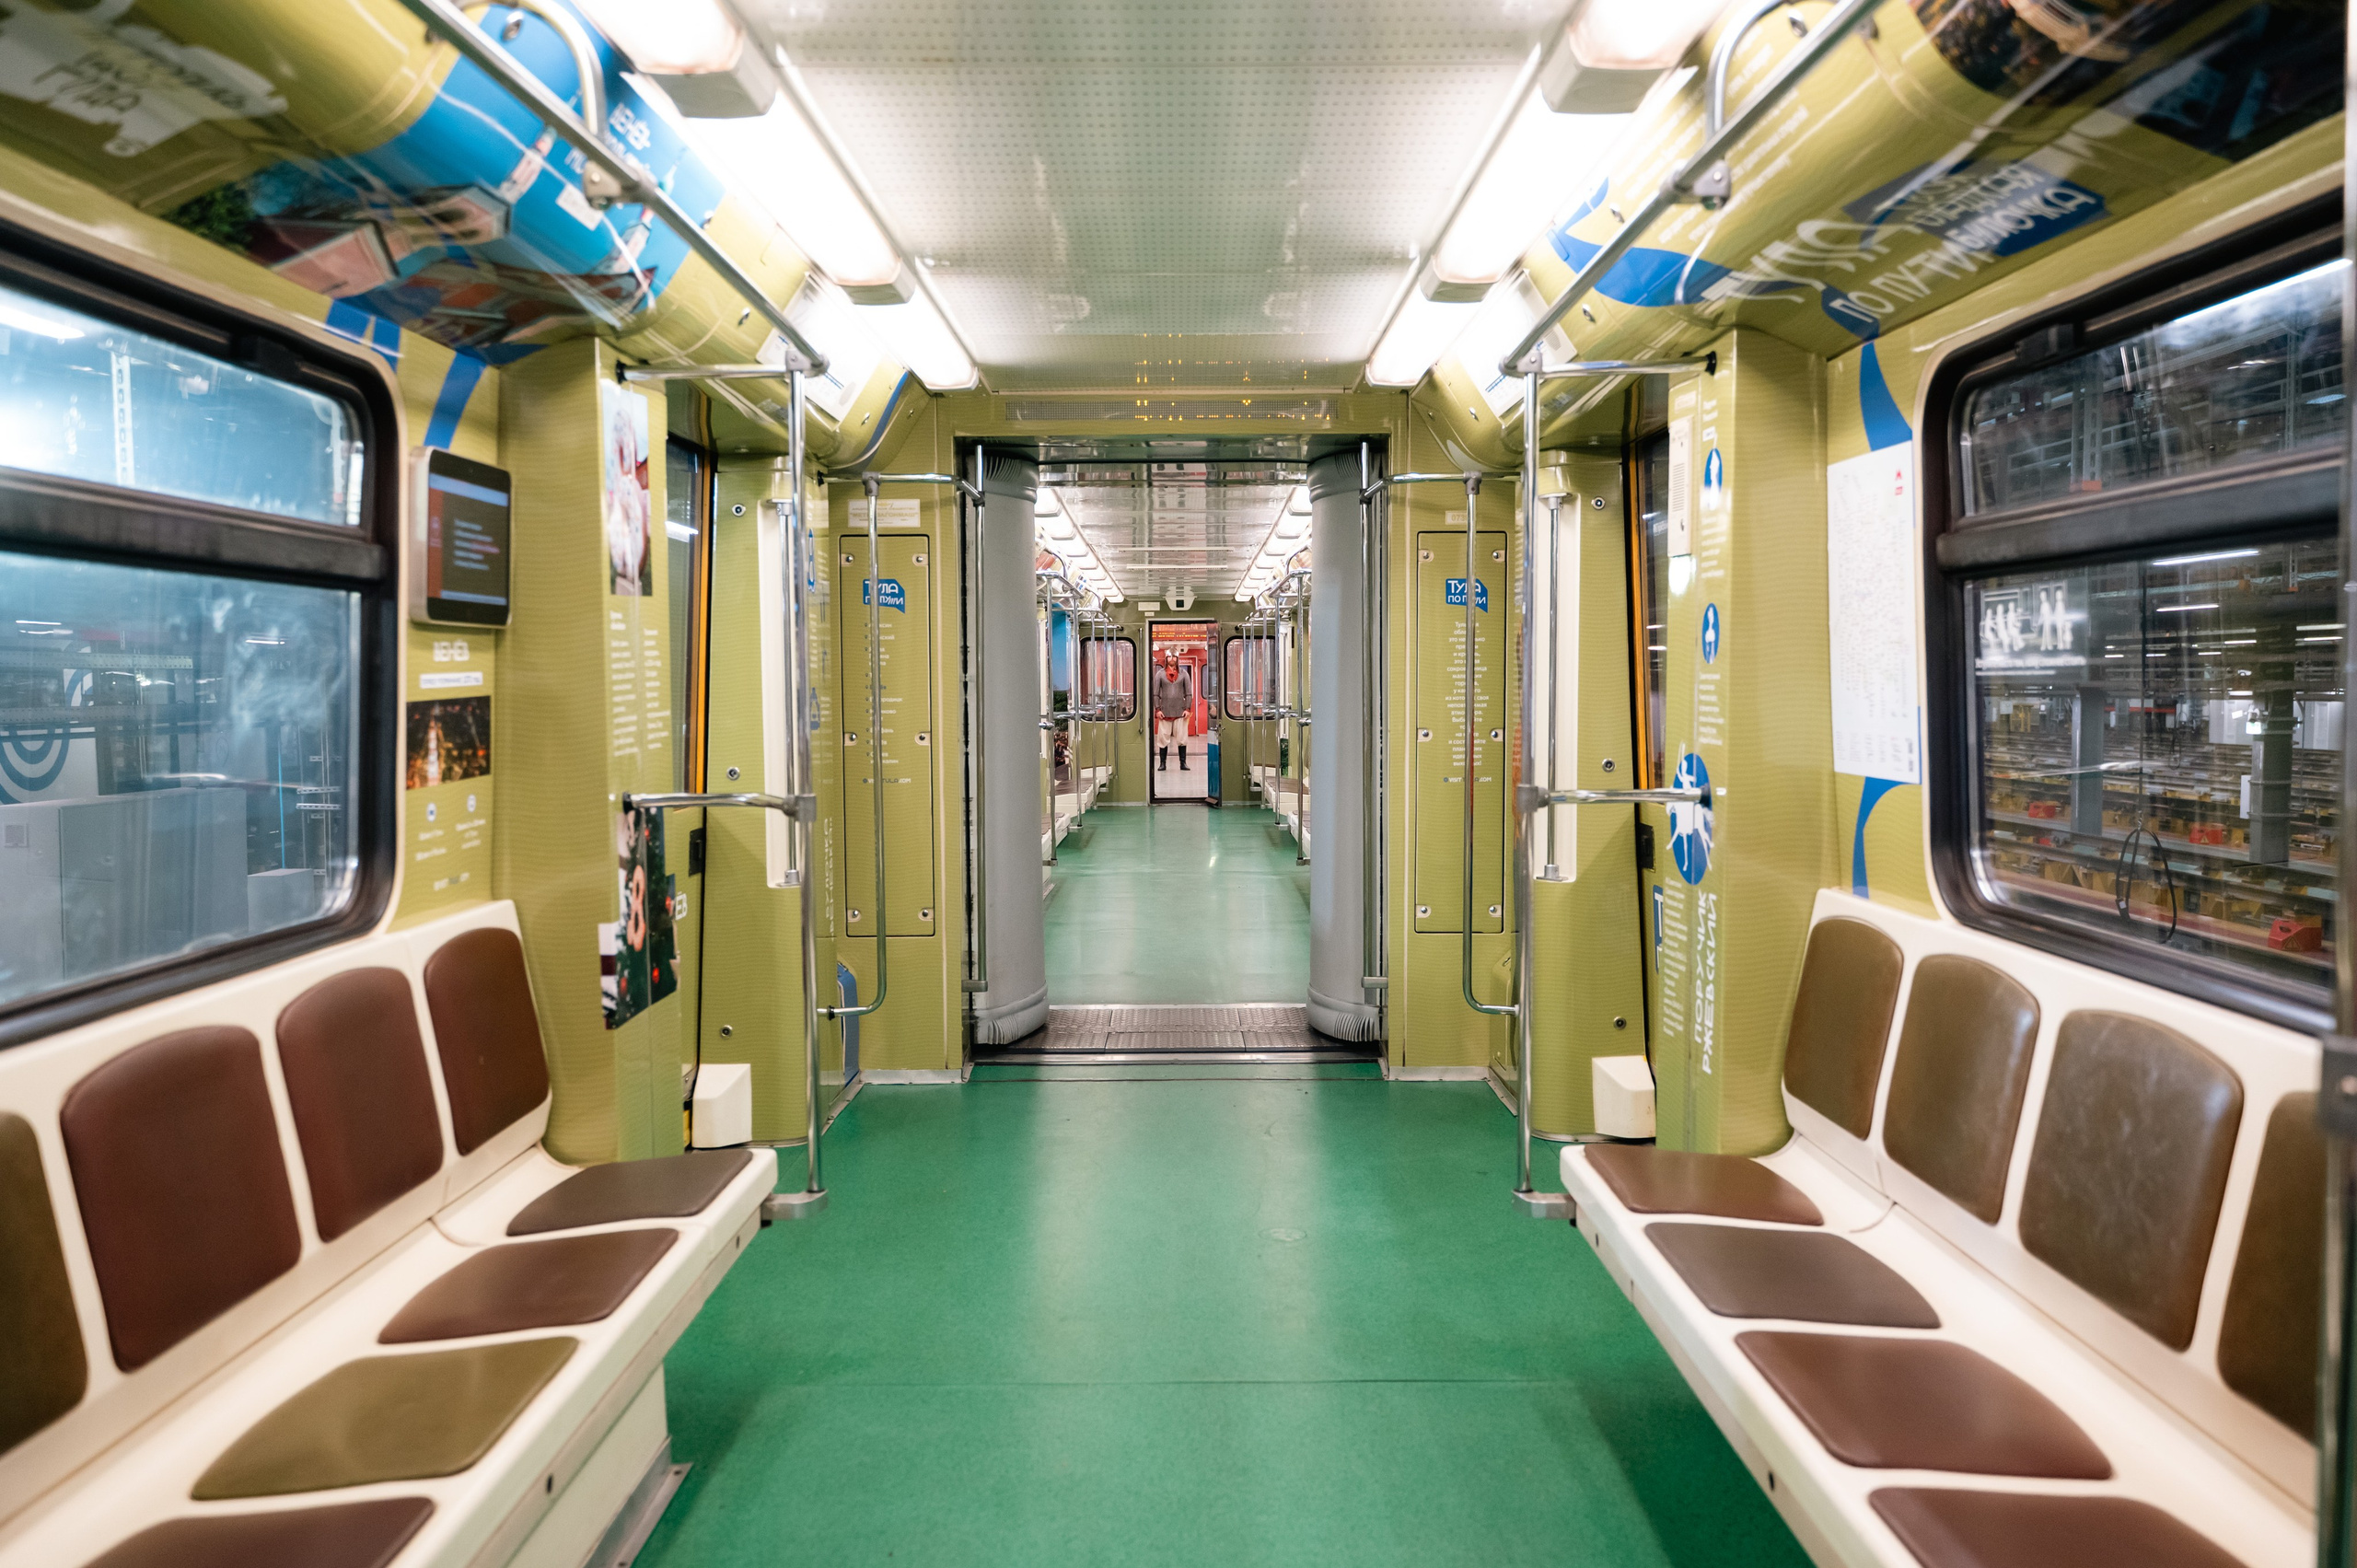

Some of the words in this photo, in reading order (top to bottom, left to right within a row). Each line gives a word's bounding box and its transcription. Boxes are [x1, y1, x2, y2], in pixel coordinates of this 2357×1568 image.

[1829, 291, 1895, 322] ПО
[865, 580, 900, 594] ТЛА
[1447, 580, 1481, 594] ТУА
[1447, 595, 1461, 603] ПО
[1694, 889, 1708, 1044] ПОРУЧИК
[1702, 892, 1717, 1075] РЖЕВСКИЙ
